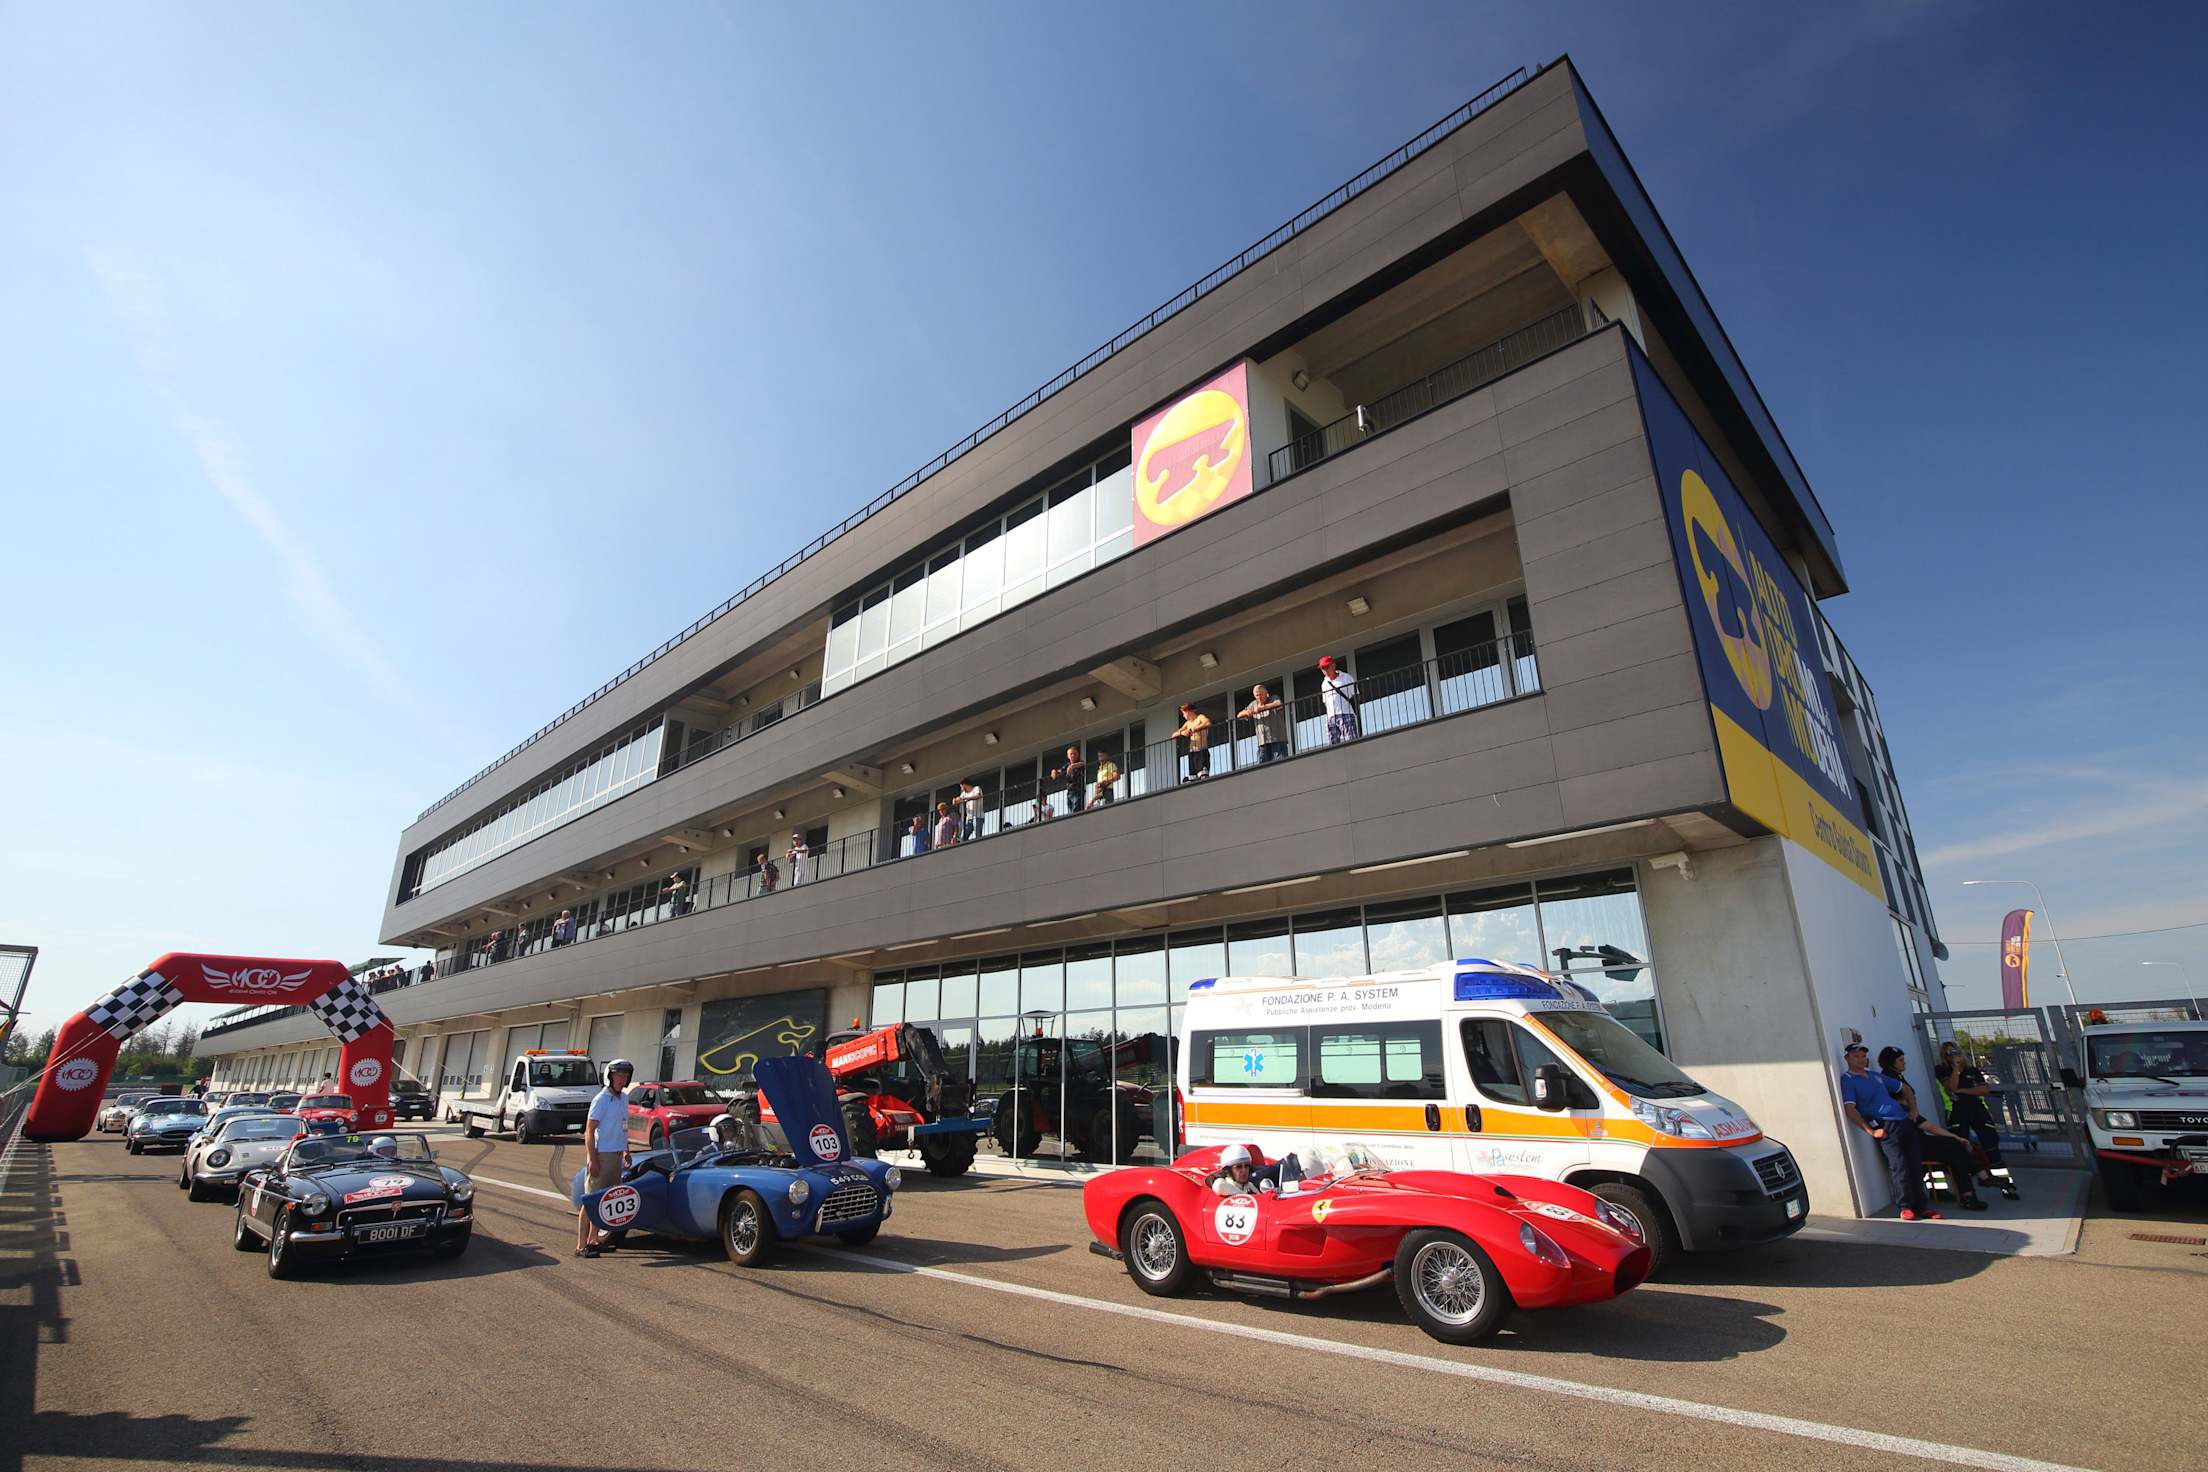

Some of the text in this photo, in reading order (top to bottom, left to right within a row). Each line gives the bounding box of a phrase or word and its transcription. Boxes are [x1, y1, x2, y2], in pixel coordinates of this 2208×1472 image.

[1749, 550, 1798, 649] AUTO
[1780, 682, 1853, 800] MODENA
[1262, 993, 1323, 1006] FONDAZIONE
[1340, 991, 1350, 1000] A.
[1354, 987, 1399, 1000] SYSTEM
[1361, 1002, 1392, 1010] Modena
[346, 1135, 360, 1143] 79
[815, 1137, 838, 1151] 103
[830, 1175, 851, 1185] 549
[605, 1198, 636, 1216] 103
[1225, 1213, 1246, 1229] 83
[369, 1225, 417, 1241] 8001 DF
